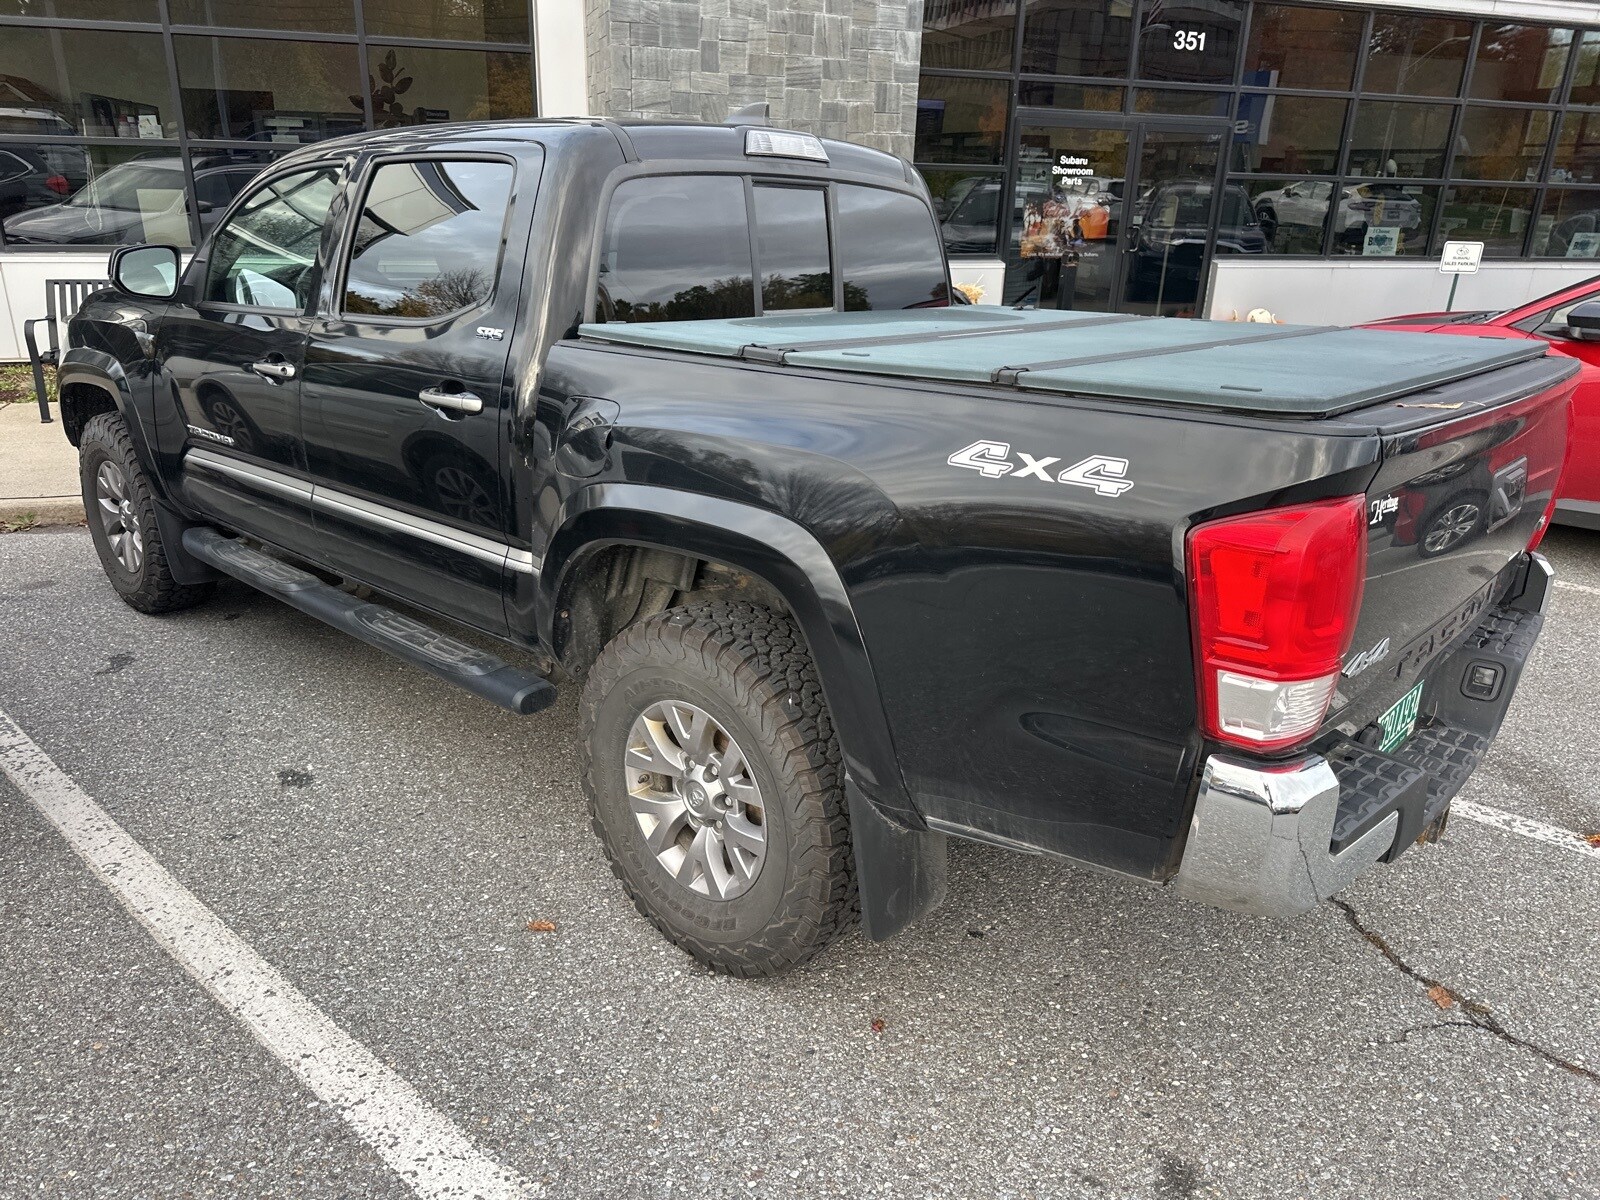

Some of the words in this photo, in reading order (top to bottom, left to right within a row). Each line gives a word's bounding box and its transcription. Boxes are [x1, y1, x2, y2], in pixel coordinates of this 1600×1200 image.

[1173, 29, 1206, 51] 351
[1059, 155, 1089, 165] Subaru
[1051, 165, 1094, 176] Showroom
[1061, 176, 1083, 186] Parts
[476, 326, 505, 341] SR5
[186, 424, 235, 446] TACOMA
